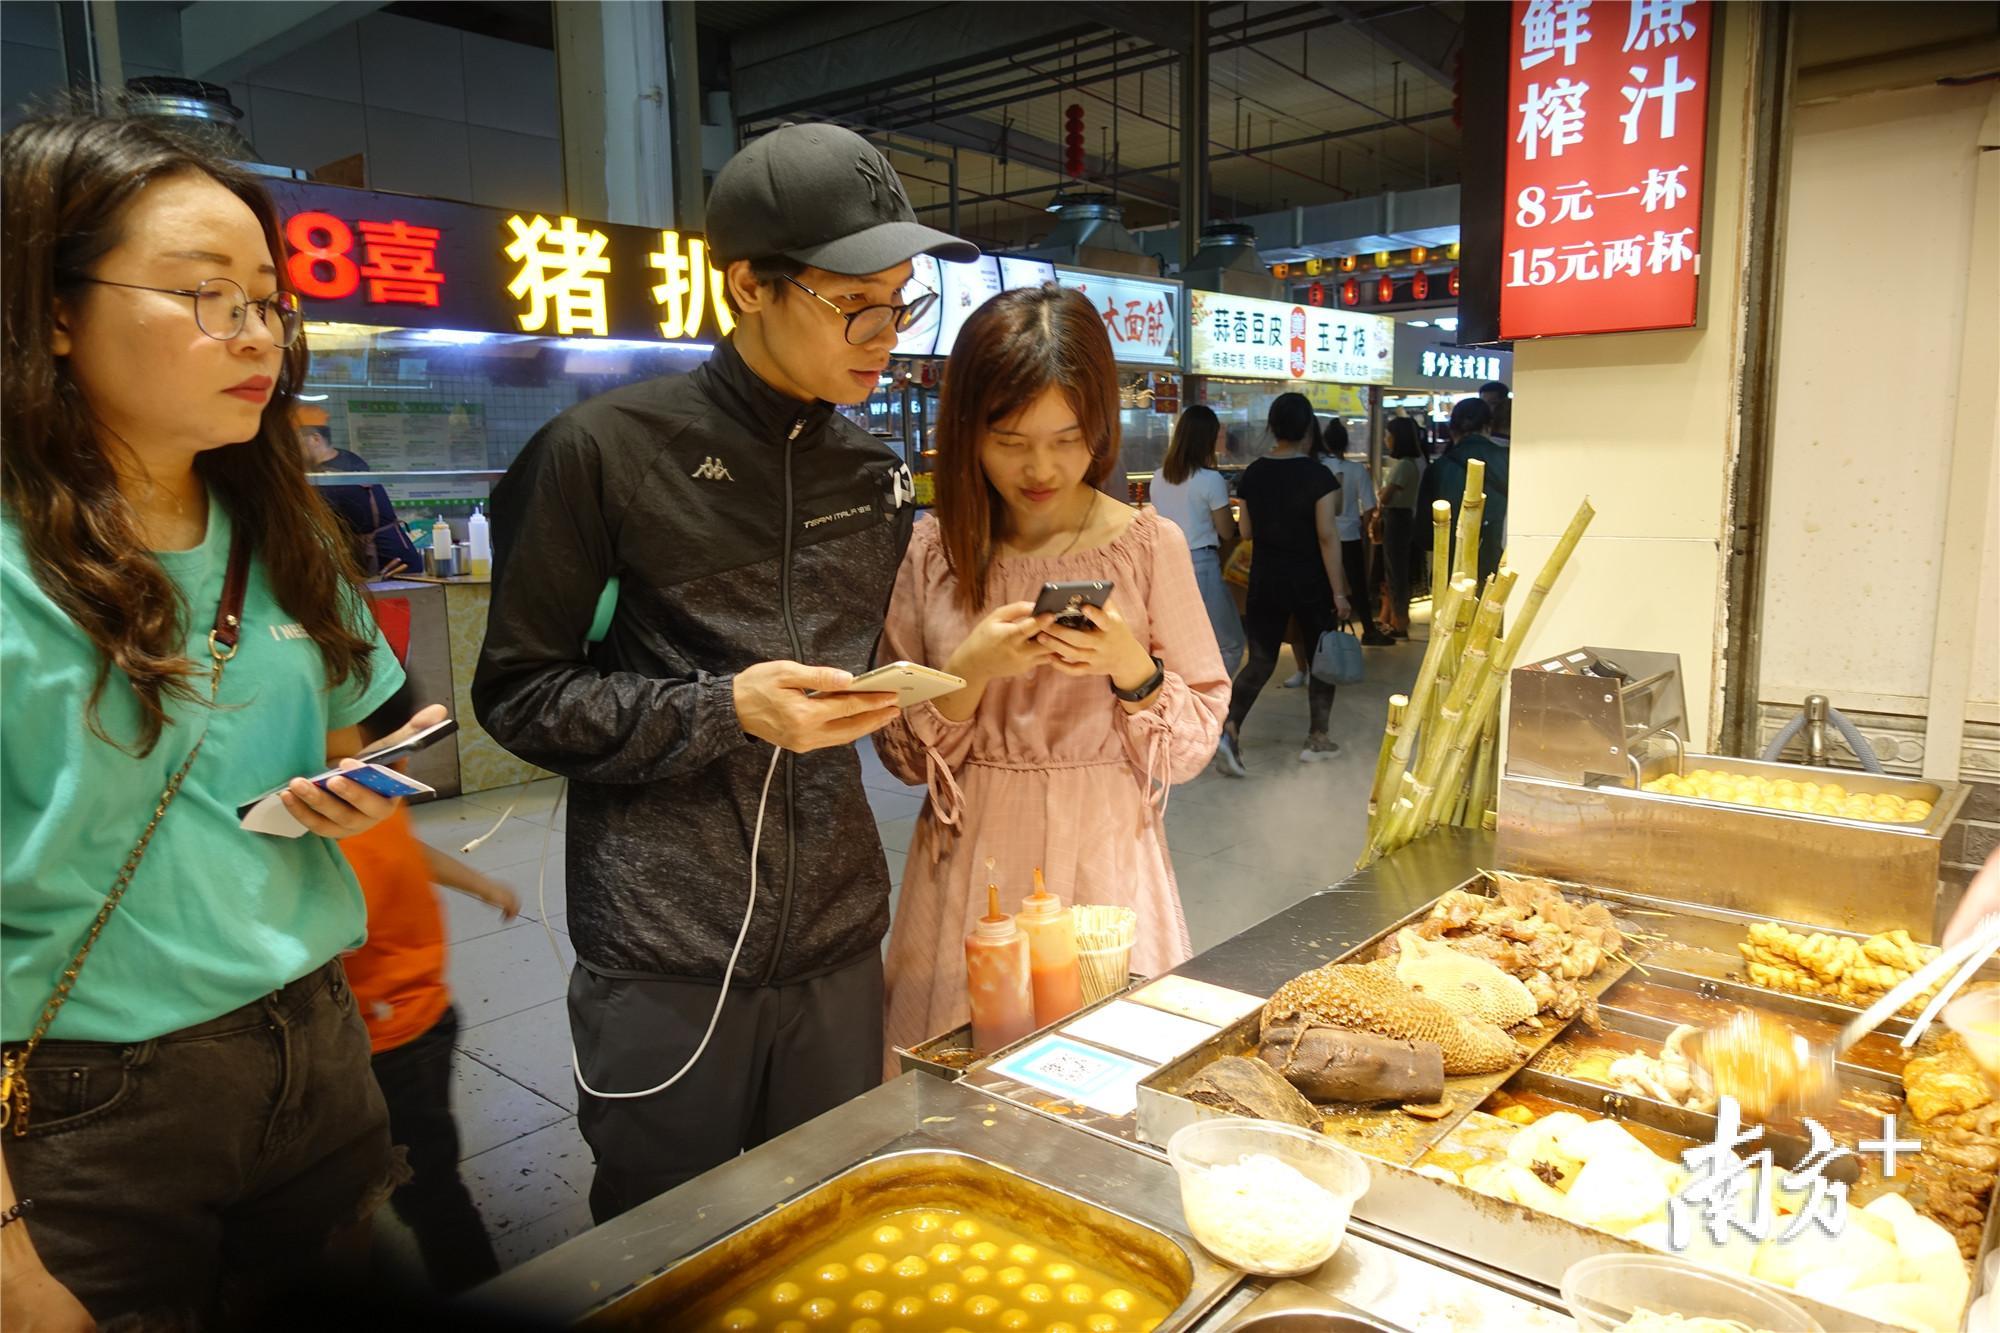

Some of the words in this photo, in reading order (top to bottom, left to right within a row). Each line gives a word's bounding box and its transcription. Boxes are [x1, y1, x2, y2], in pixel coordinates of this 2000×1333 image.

[1517, 0, 1593, 160] 鲜榨
[1515, 164, 1689, 228] 8元一杯
[286, 210, 446, 308] 8喜
[1506, 228, 1694, 287] 15元两杯
[1213, 308, 1283, 347] 蒜香豆皮
[1317, 322, 1366, 357] 玉子烧
